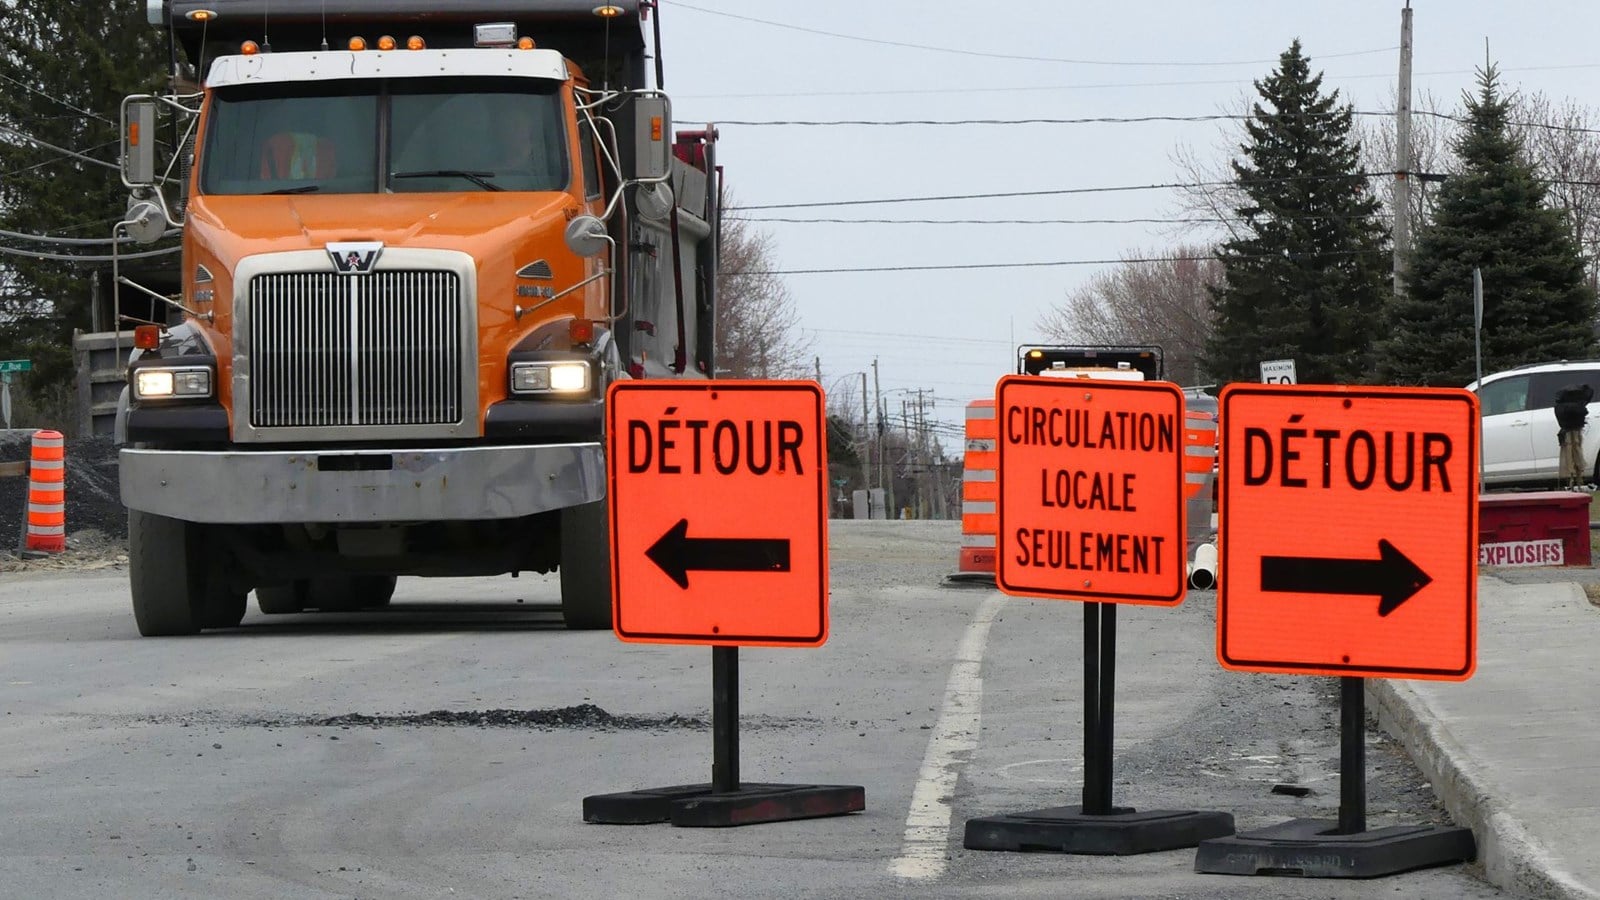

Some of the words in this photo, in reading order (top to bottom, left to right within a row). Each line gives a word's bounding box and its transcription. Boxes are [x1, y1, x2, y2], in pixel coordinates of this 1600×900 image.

[629, 407, 803, 475] DÉTOUR
[1009, 406, 1173, 452] CIRCULATION
[1245, 415, 1452, 492] DÉTOUR
[1043, 470, 1135, 511] LOCALE
[1017, 528, 1164, 574] SEULEMENT
